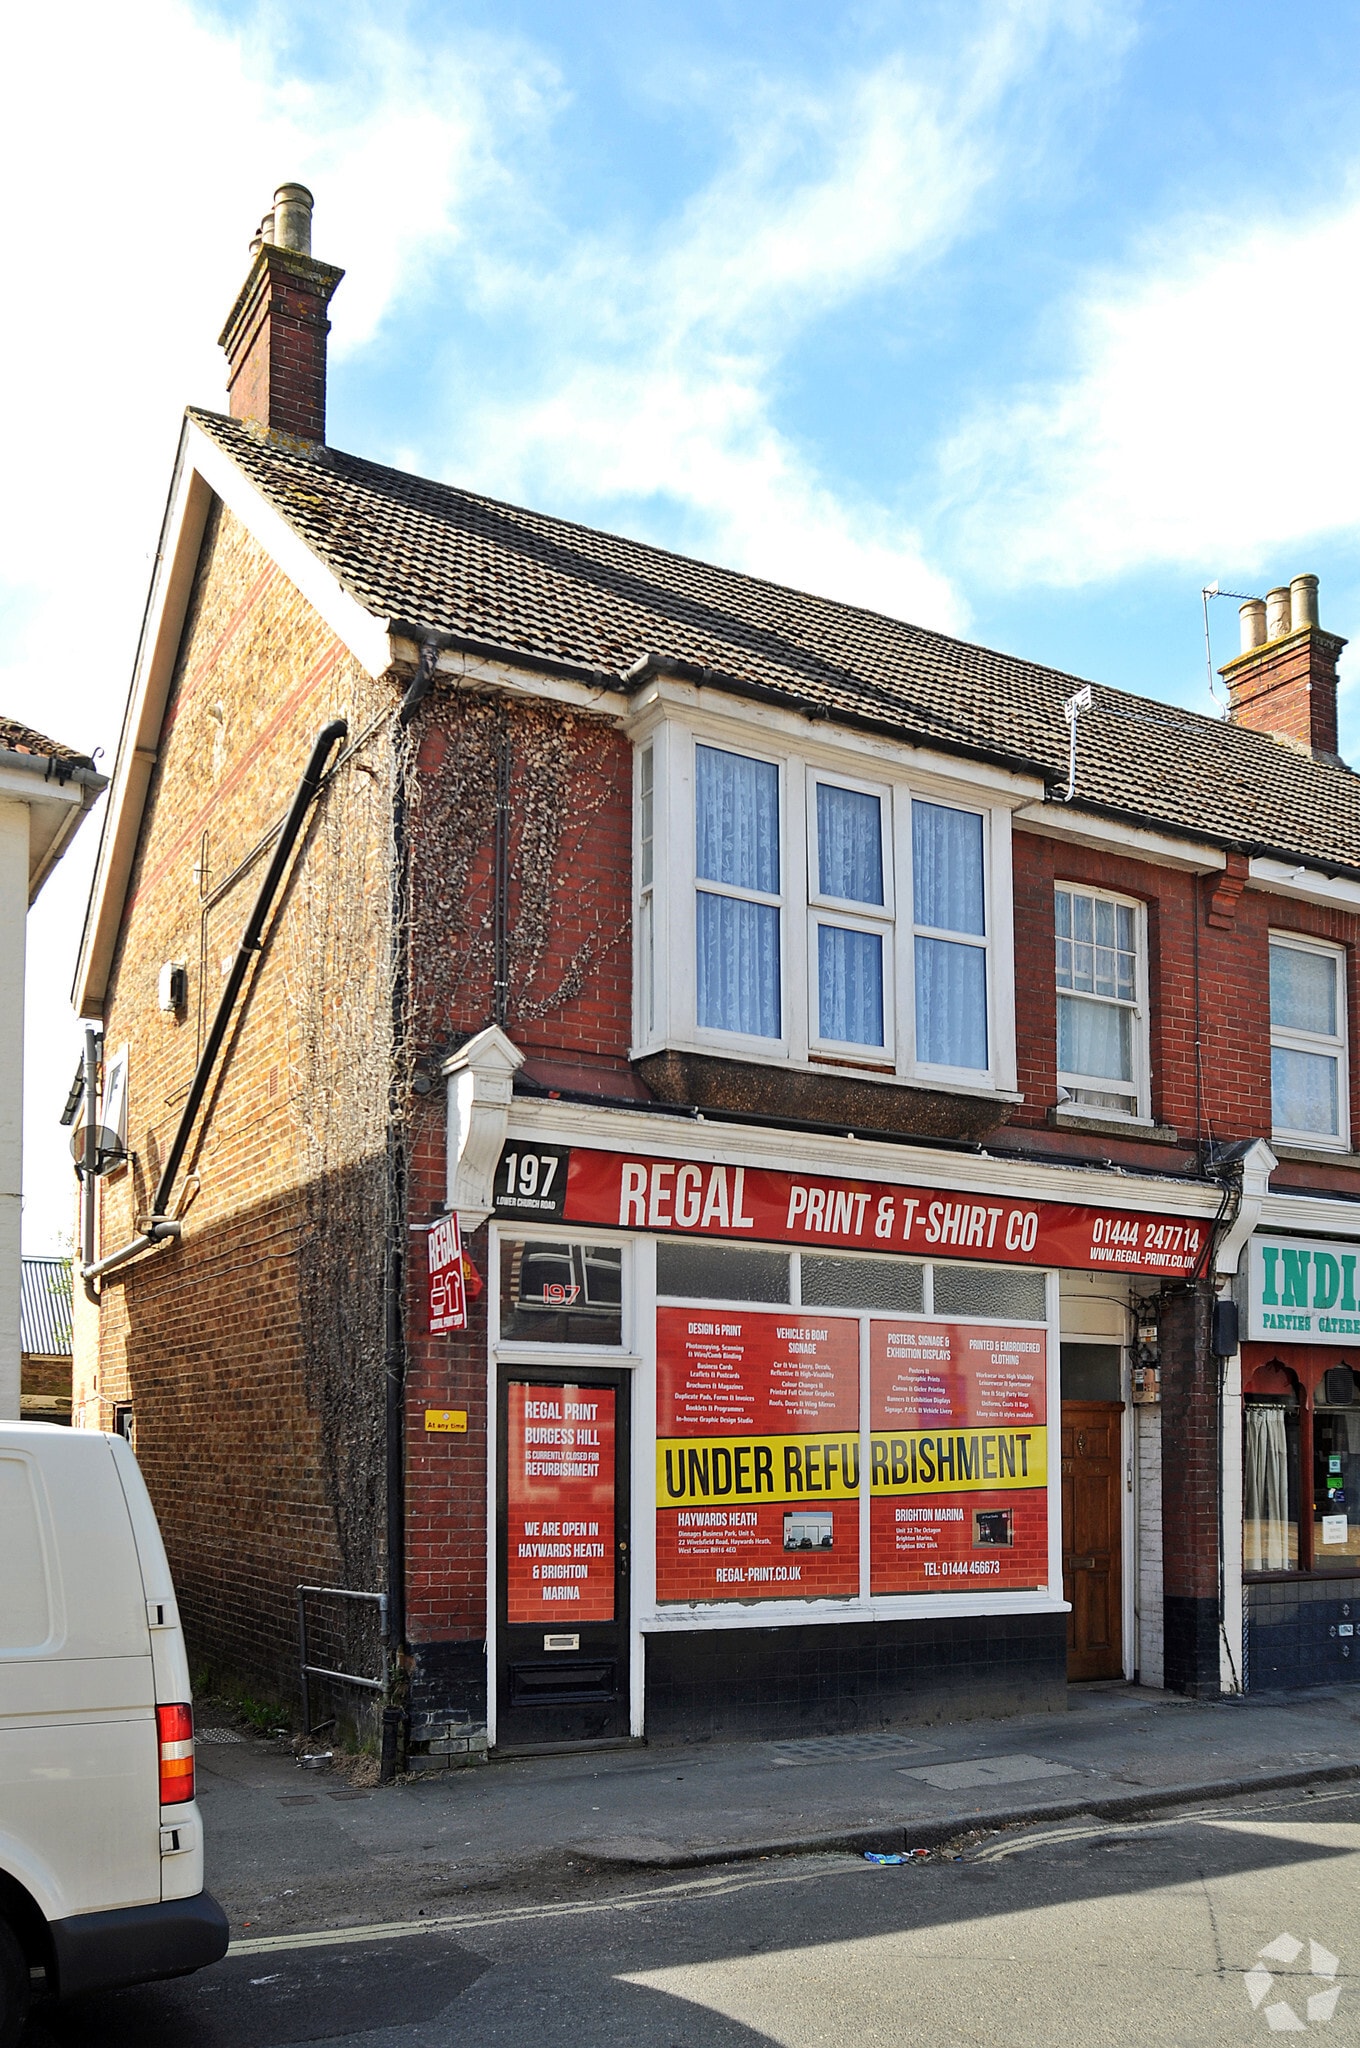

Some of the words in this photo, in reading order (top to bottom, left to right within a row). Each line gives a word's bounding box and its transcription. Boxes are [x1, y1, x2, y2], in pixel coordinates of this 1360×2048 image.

[505, 1152, 559, 1197] 197
[496, 1196, 517, 1207] LOWER
[517, 1197, 540, 1209] CHURCH
[540, 1199, 556, 1210] ROAD
[618, 1162, 754, 1229] REGAL
[786, 1185, 872, 1236] PRINT
[874, 1196, 895, 1239] &
[902, 1198, 1003, 1248] T-SHIRT
[1005, 1209, 1039, 1252] CO
[1092, 1217, 1140, 1247] 01444
[1143, 1223, 1200, 1253] 247714
[428, 1217, 460, 1274] REGAL
[1089, 1246, 1196, 1269] WWW.REGAL-PRINT.CO.UK
[1262, 1246, 1360, 1312] INDI
[543, 1283, 581, 1305] 197
[1262, 1312, 1311, 1331] PARTIES
[688, 1323, 713, 1334] DESIGN
[715, 1324, 720, 1335] &
[722, 1325, 741, 1336] PRINT
[777, 1328, 804, 1340] VEHICLE
[805, 1329, 810, 1340] &
[812, 1330, 827, 1340] BOAT
[888, 1334, 917, 1345] POSTERS,
[918, 1335, 944, 1346] SIGNAGE
[945, 1337, 949, 1347] &
[969, 1340, 994, 1350] PRINTED
[995, 1341, 1000, 1351] &
[1000, 1341, 1040, 1353] EMBROIDERED
[722, 1344, 744, 1352] Scanning
[789, 1342, 816, 1354] SIGNAGE
[887, 1347, 921, 1358] EXHIBITION
[922, 1349, 950, 1360] DISPLAYS
[991, 1354, 1019, 1365] CLOTHING
[719, 1363, 733, 1371] Cards
[525, 1401, 562, 1419] REGAL
[564, 1403, 597, 1421] PRINT
[714, 1405, 744, 1413] Programmes
[805, 1401, 817, 1409] Wing
[437, 1422, 449, 1430] any
[525, 1427, 574, 1445] BURGESS
[577, 1429, 600, 1445] HILL
[525, 1450, 533, 1461] IS
[532, 1450, 567, 1461] CURRENTLY
[566, 1451, 587, 1461] CLOSED
[588, 1452, 599, 1461] FOR
[525, 1461, 599, 1477] REFURBISHMENT
[665, 1445, 774, 1498] UNDER
[783, 1434, 1032, 1493] REFURBISHMENT
[678, 1513, 727, 1526] HAYWARDS
[729, 1513, 757, 1526] HEATH
[896, 1509, 933, 1521] BRIGHTON
[935, 1509, 963, 1520] MARINA
[525, 1522, 539, 1536] WE
[542, 1522, 560, 1536] ARE
[563, 1522, 586, 1536] OPEN
[589, 1522, 598, 1536] IN
[519, 1544, 571, 1557] HAYWARDS
[574, 1544, 604, 1557] HEATH
[533, 1565, 539, 1579] &
[542, 1565, 587, 1578] BRIGHTON
[717, 1567, 801, 1582] REGAL-PRINT.CO.UK
[924, 1563, 940, 1575] TEL:
[942, 1562, 968, 1575] 01444
[970, 1561, 999, 1574] 456673
[543, 1586, 580, 1600] MARINA
